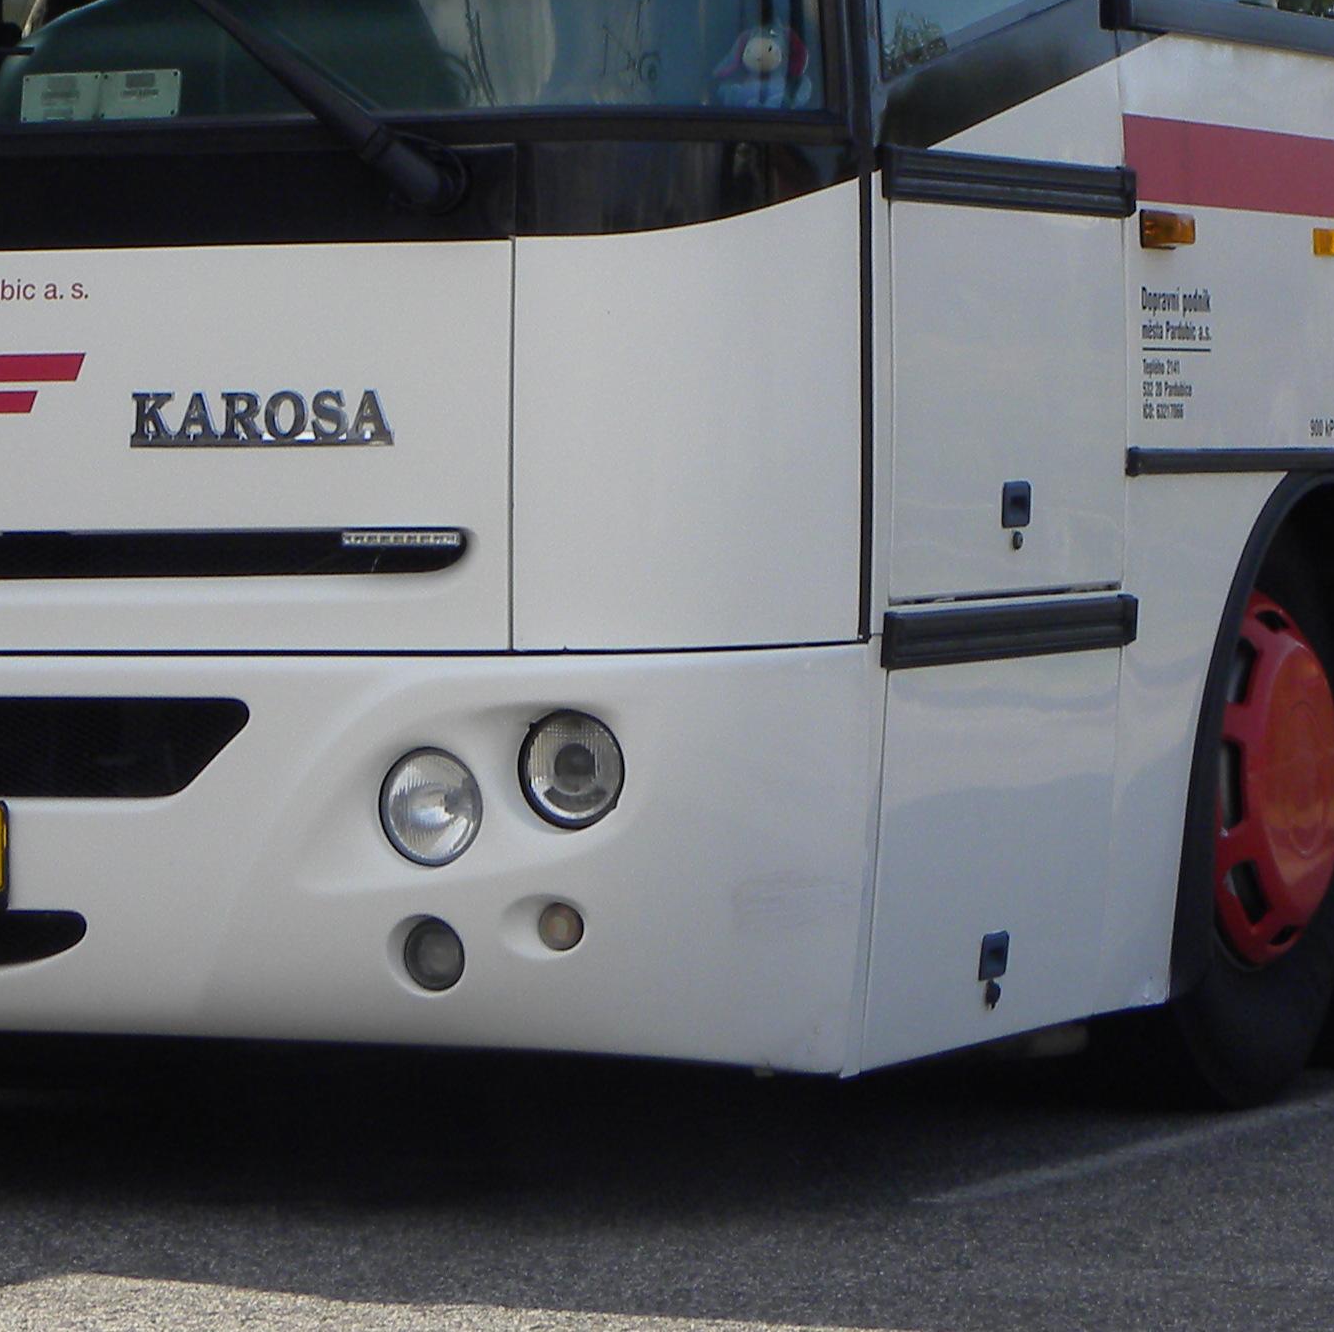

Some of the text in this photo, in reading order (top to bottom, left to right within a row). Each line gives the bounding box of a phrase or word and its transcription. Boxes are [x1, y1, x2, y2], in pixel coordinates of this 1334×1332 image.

[43, 283, 63, 301] a.
[70, 282, 88, 300] s.
[1141, 286, 1211, 318] Dopravní podnik
[1141, 319, 1163, 340] města
[1165, 320, 1196, 341] Pardubic
[1166, 359, 1181, 375] 2141
[1164, 381, 1193, 397] Pardubice
[130, 389, 395, 446] KAROSA
[1309, 418, 1323, 437] 900
